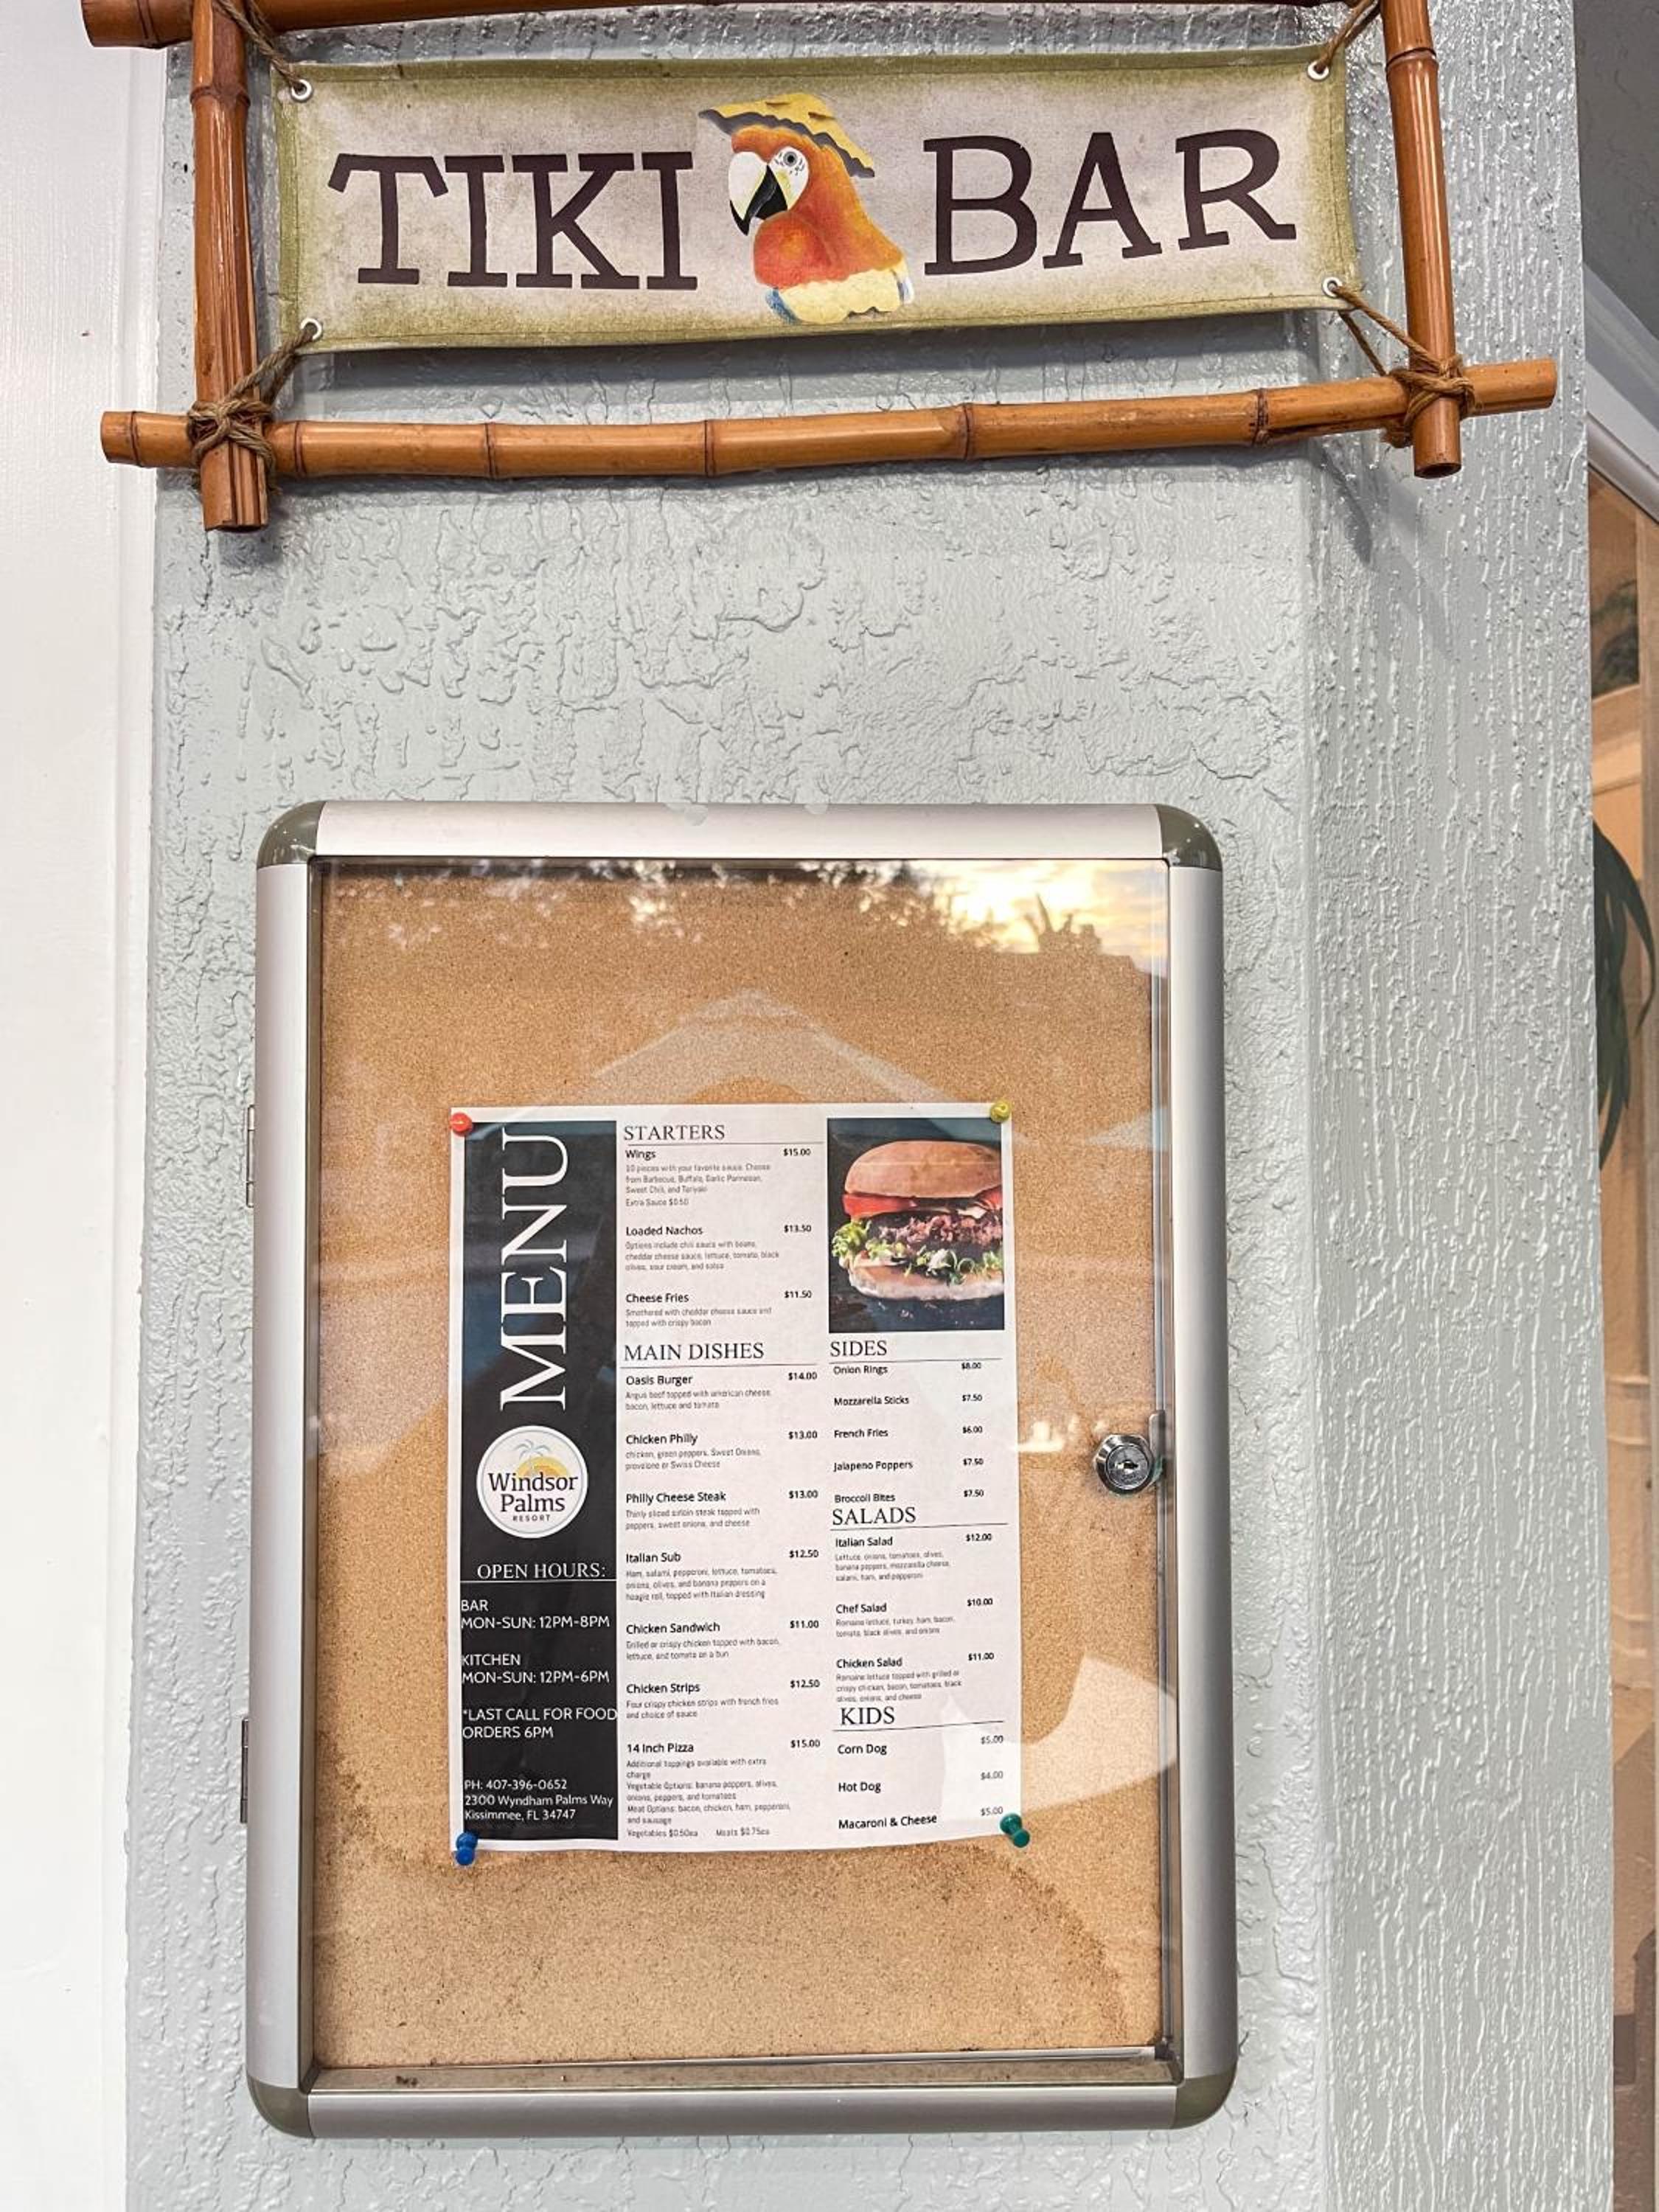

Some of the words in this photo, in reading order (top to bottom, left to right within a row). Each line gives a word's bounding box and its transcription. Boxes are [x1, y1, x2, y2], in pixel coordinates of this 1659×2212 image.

[328, 151, 698, 290] TIKI
[923, 130, 1296, 275] BAR
[624, 1125, 725, 1140] STARTERS
[625, 1150, 655, 1161] Wings
[626, 1227, 662, 1236] Loaded
[666, 1226, 703, 1234] Nachos
[785, 1225, 811, 1233] $13.50
[501, 1128, 568, 1410] MENU
[626, 1294, 662, 1302] Cheese
[666, 1293, 689, 1302] Fries
[625, 1345, 681, 1360] MAIN
[689, 1343, 764, 1360] DISHES
[831, 1340, 886, 1357] SIDES
[832, 1363, 861, 1374] Onion
[864, 1366, 888, 1375] Rings
[626, 1376, 654, 1385] Oasis
[658, 1376, 692, 1386] Burger
[788, 1372, 817, 1380] $14.00
[835, 1397, 882, 1405] Mozzarella
[626, 1435, 667, 1444] Chicken
[669, 1433, 698, 1445] Philly
[789, 1430, 817, 1439] $13.00
[835, 1429, 864, 1438] French
[833, 1463, 873, 1472] Jalapeno
[876, 1461, 913, 1471] Poppers
[488, 1472, 578, 1491] Windsor
[501, 1492, 565, 1514] Palms
[627, 1494, 653, 1506] Philly
[656, 1493, 695, 1503] Cheese
[698, 1492, 726, 1501] Steak
[789, 1490, 818, 1498] $13.00
[835, 1494, 870, 1503] Broccoli
[832, 1507, 916, 1525] SALADS
[836, 1538, 864, 1547] Italian
[867, 1537, 893, 1545] Salad
[966, 1534, 992, 1542] $12.00
[627, 1554, 658, 1563] Italian
[661, 1553, 681, 1562] Sub
[790, 1550, 818, 1558] $12.50
[478, 1565, 527, 1579] OPEN
[535, 1563, 605, 1579] HOURS:
[461, 1600, 488, 1610] BAR
[836, 1604, 858, 1613] Chef
[861, 1603, 886, 1613] Salad
[461, 1618, 536, 1629] MON-SUN:
[540, 1616, 610, 1627] 12PM-8PM
[627, 1624, 667, 1634] Chicken
[670, 1623, 720, 1632] Sandwich
[461, 1654, 521, 1665] KITCHEN
[836, 1659, 874, 1668] Chicken
[877, 1658, 902, 1666] Salad
[969, 1652, 994, 1660] $11.00
[462, 1673, 536, 1683] MON-SUN:
[540, 1672, 609, 1683] 12PM-6PM
[627, 1684, 667, 1694] Chicken
[671, 1683, 700, 1694] Strips
[790, 1680, 820, 1688] $12.50
[506, 1709, 540, 1719] CALL
[544, 1708, 573, 1719] FOR
[576, 1708, 617, 1719] FOOD
[841, 1706, 894, 1725] KIDS
[463, 1727, 520, 1738] ORDERS
[525, 1727, 553, 1738] 6PM
[627, 1745, 639, 1753] 14
[643, 1744, 664, 1753] Inch
[668, 1743, 694, 1752] Pizza
[790, 1739, 820, 1747] $15.00
[838, 1745, 863, 1754] Corn
[866, 1744, 886, 1755] Dog
[981, 1736, 1004, 1745] $5.00
[465, 1781, 484, 1790] PH:
[486, 1780, 567, 1790] 407-396-0652
[839, 1783, 857, 1792] Hot
[860, 1781, 880, 1793] Dog
[981, 1771, 1003, 1780] $4.00
[465, 1795, 495, 1806] 2300
[498, 1795, 552, 1808] Wyndham
[555, 1795, 588, 1805] Palms
[591, 1795, 613, 1807] Way
[465, 1810, 524, 1820] Kissimmee,
[527, 1810, 539, 1820] FL
[543, 1810, 575, 1819] 34747
[839, 1820, 886, 1829] Macaroni
[890, 1818, 897, 1826] &
[901, 1815, 936, 1826] Cheese
[981, 1806, 1004, 1818] $5.00
